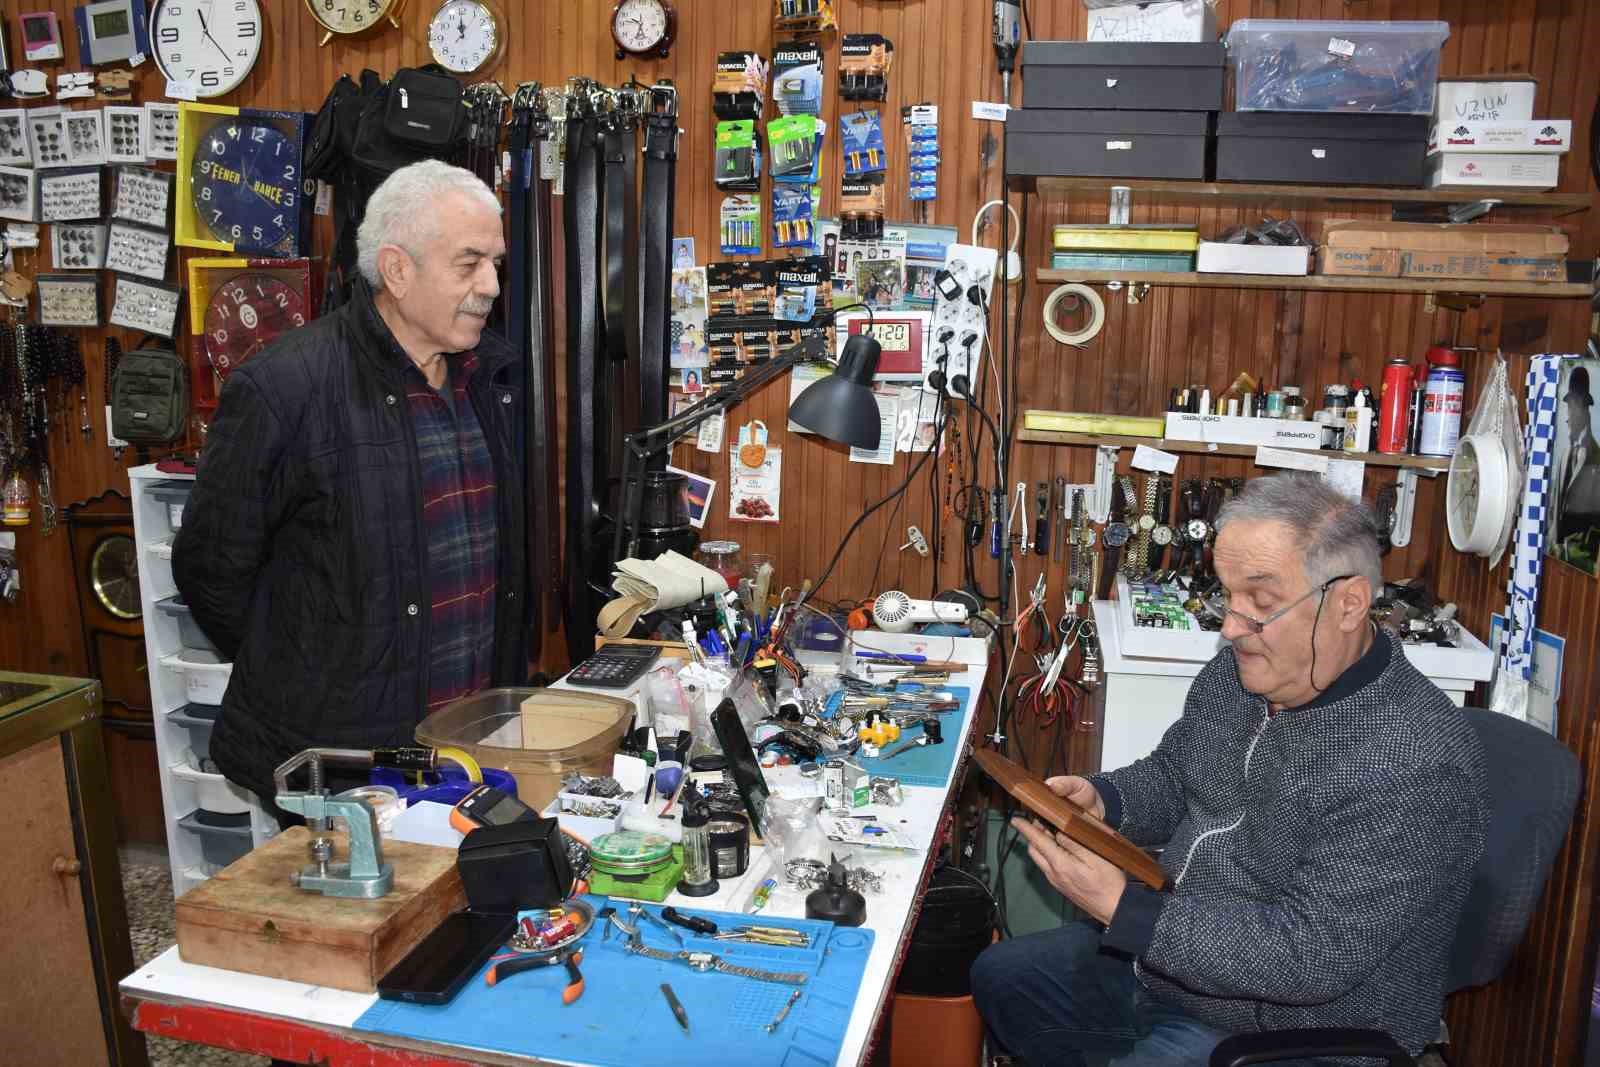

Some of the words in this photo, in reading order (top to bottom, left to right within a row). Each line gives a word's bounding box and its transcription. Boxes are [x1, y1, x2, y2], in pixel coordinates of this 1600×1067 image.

[167, 7, 181, 16] 10
[235, 1, 246, 11] 2
[337, 8, 346, 20] 7
[354, 10, 363, 22] 6
[161, 27, 179, 43] 9
[236, 21, 256, 38] 3
[171, 53, 181, 63] 8
[237, 48, 248, 57] 4
[776, 49, 817, 61] maxell
[185, 69, 195, 79] 7
[223, 67, 234, 76] 5
[201, 71, 219, 87] 6
[251, 126, 266, 143] 12
[211, 139, 226, 155] 10
[275, 142, 282, 156] 1
[200, 160, 211, 174] 9
[212, 163, 241, 185] FENER
[283, 164, 295, 180] 2
[201, 187, 212, 201] 8
[283, 192, 295, 207] 3
[212, 209, 223, 223] 7
[272, 214, 283, 227] 4
[231, 224, 242, 238] 6
[252, 226, 263, 240] 5
[779, 272, 817, 283] maxell
[231, 287, 248, 304] 12
[276, 292, 289, 308] 2
[217, 304, 231, 319] 11
[292, 312, 305, 327] 3
[213, 328, 229, 344] 10
[218, 354, 230, 368] 9
[1276, 431, 1316, 440] CHOPPERS
